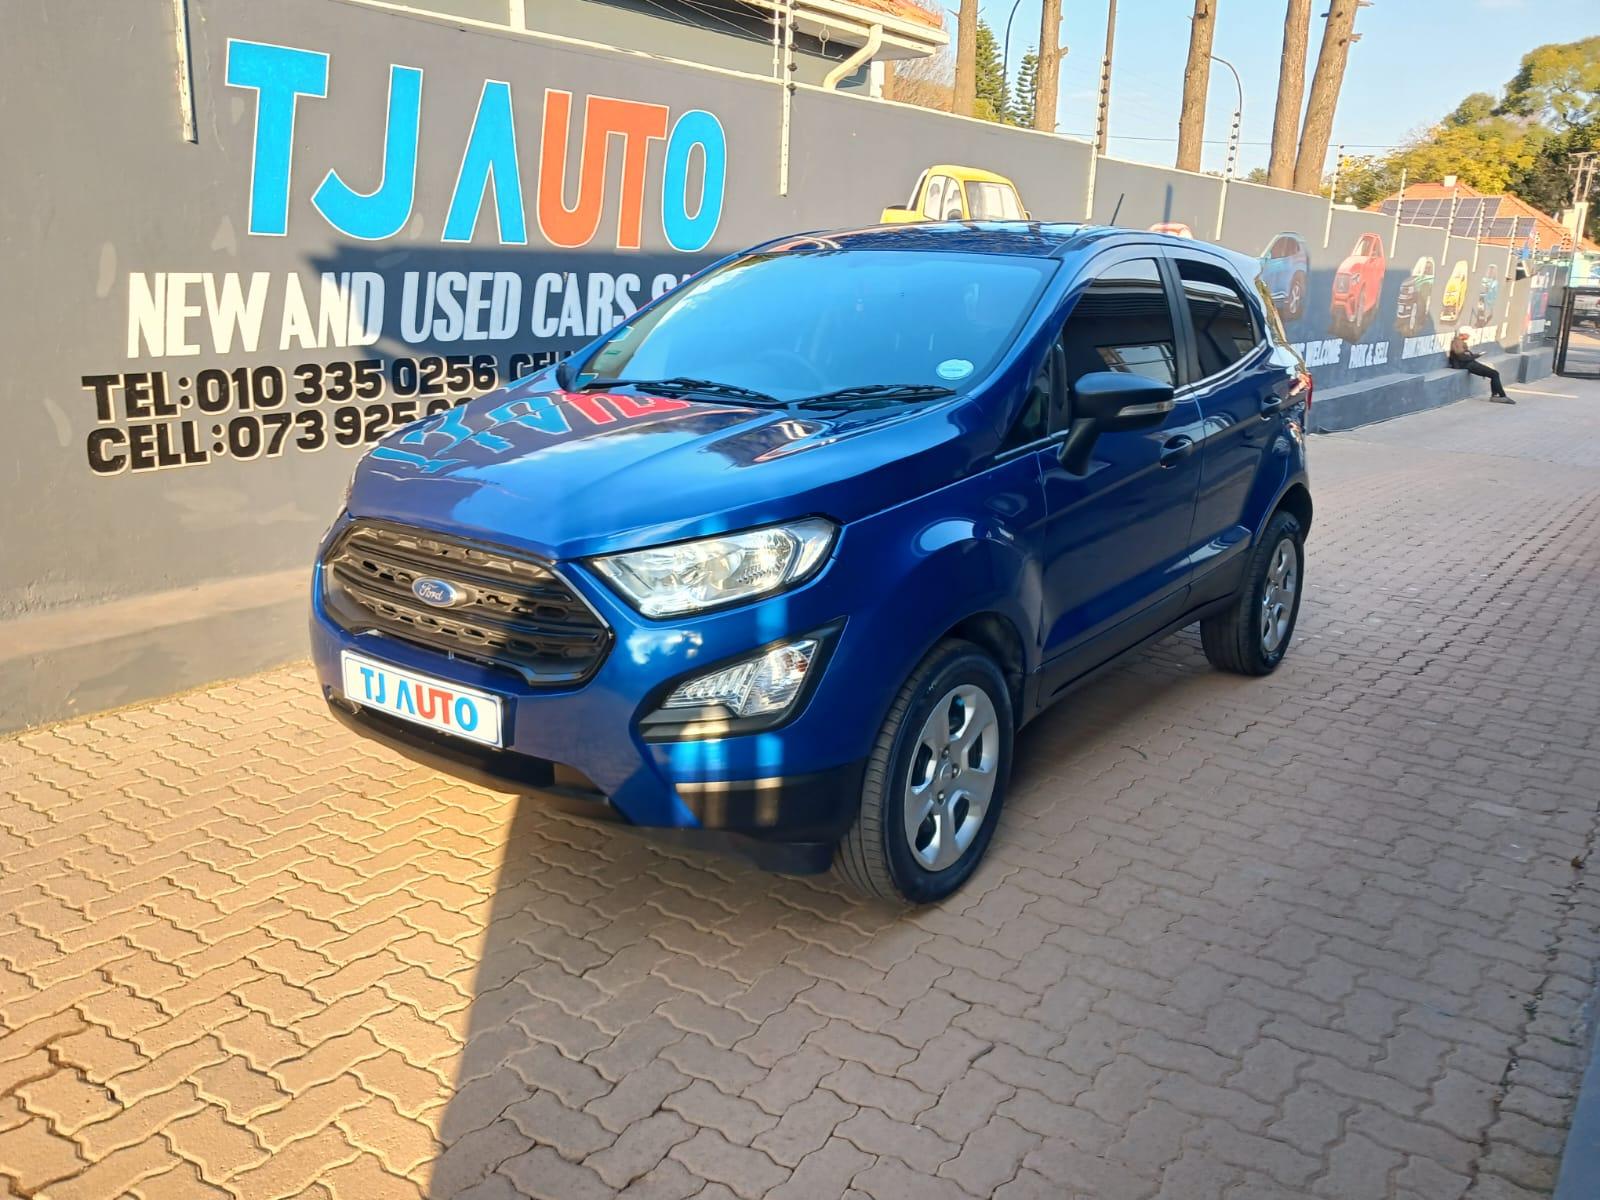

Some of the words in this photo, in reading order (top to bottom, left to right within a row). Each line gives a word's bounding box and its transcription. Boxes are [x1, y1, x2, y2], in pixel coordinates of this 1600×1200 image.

[225, 38, 424, 240] TJ
[441, 79, 727, 252] AUTO
[127, 271, 270, 359] NEW
[279, 271, 385, 350] AND
[400, 271, 522, 343] USED
[531, 272, 641, 338] CARS
[293, 359, 385, 407] 335
[391, 354, 499, 398] 0256
[419, 582, 444, 601] Ford
[360, 666, 386, 704] TJ
[396, 680, 478, 732] AUTO
